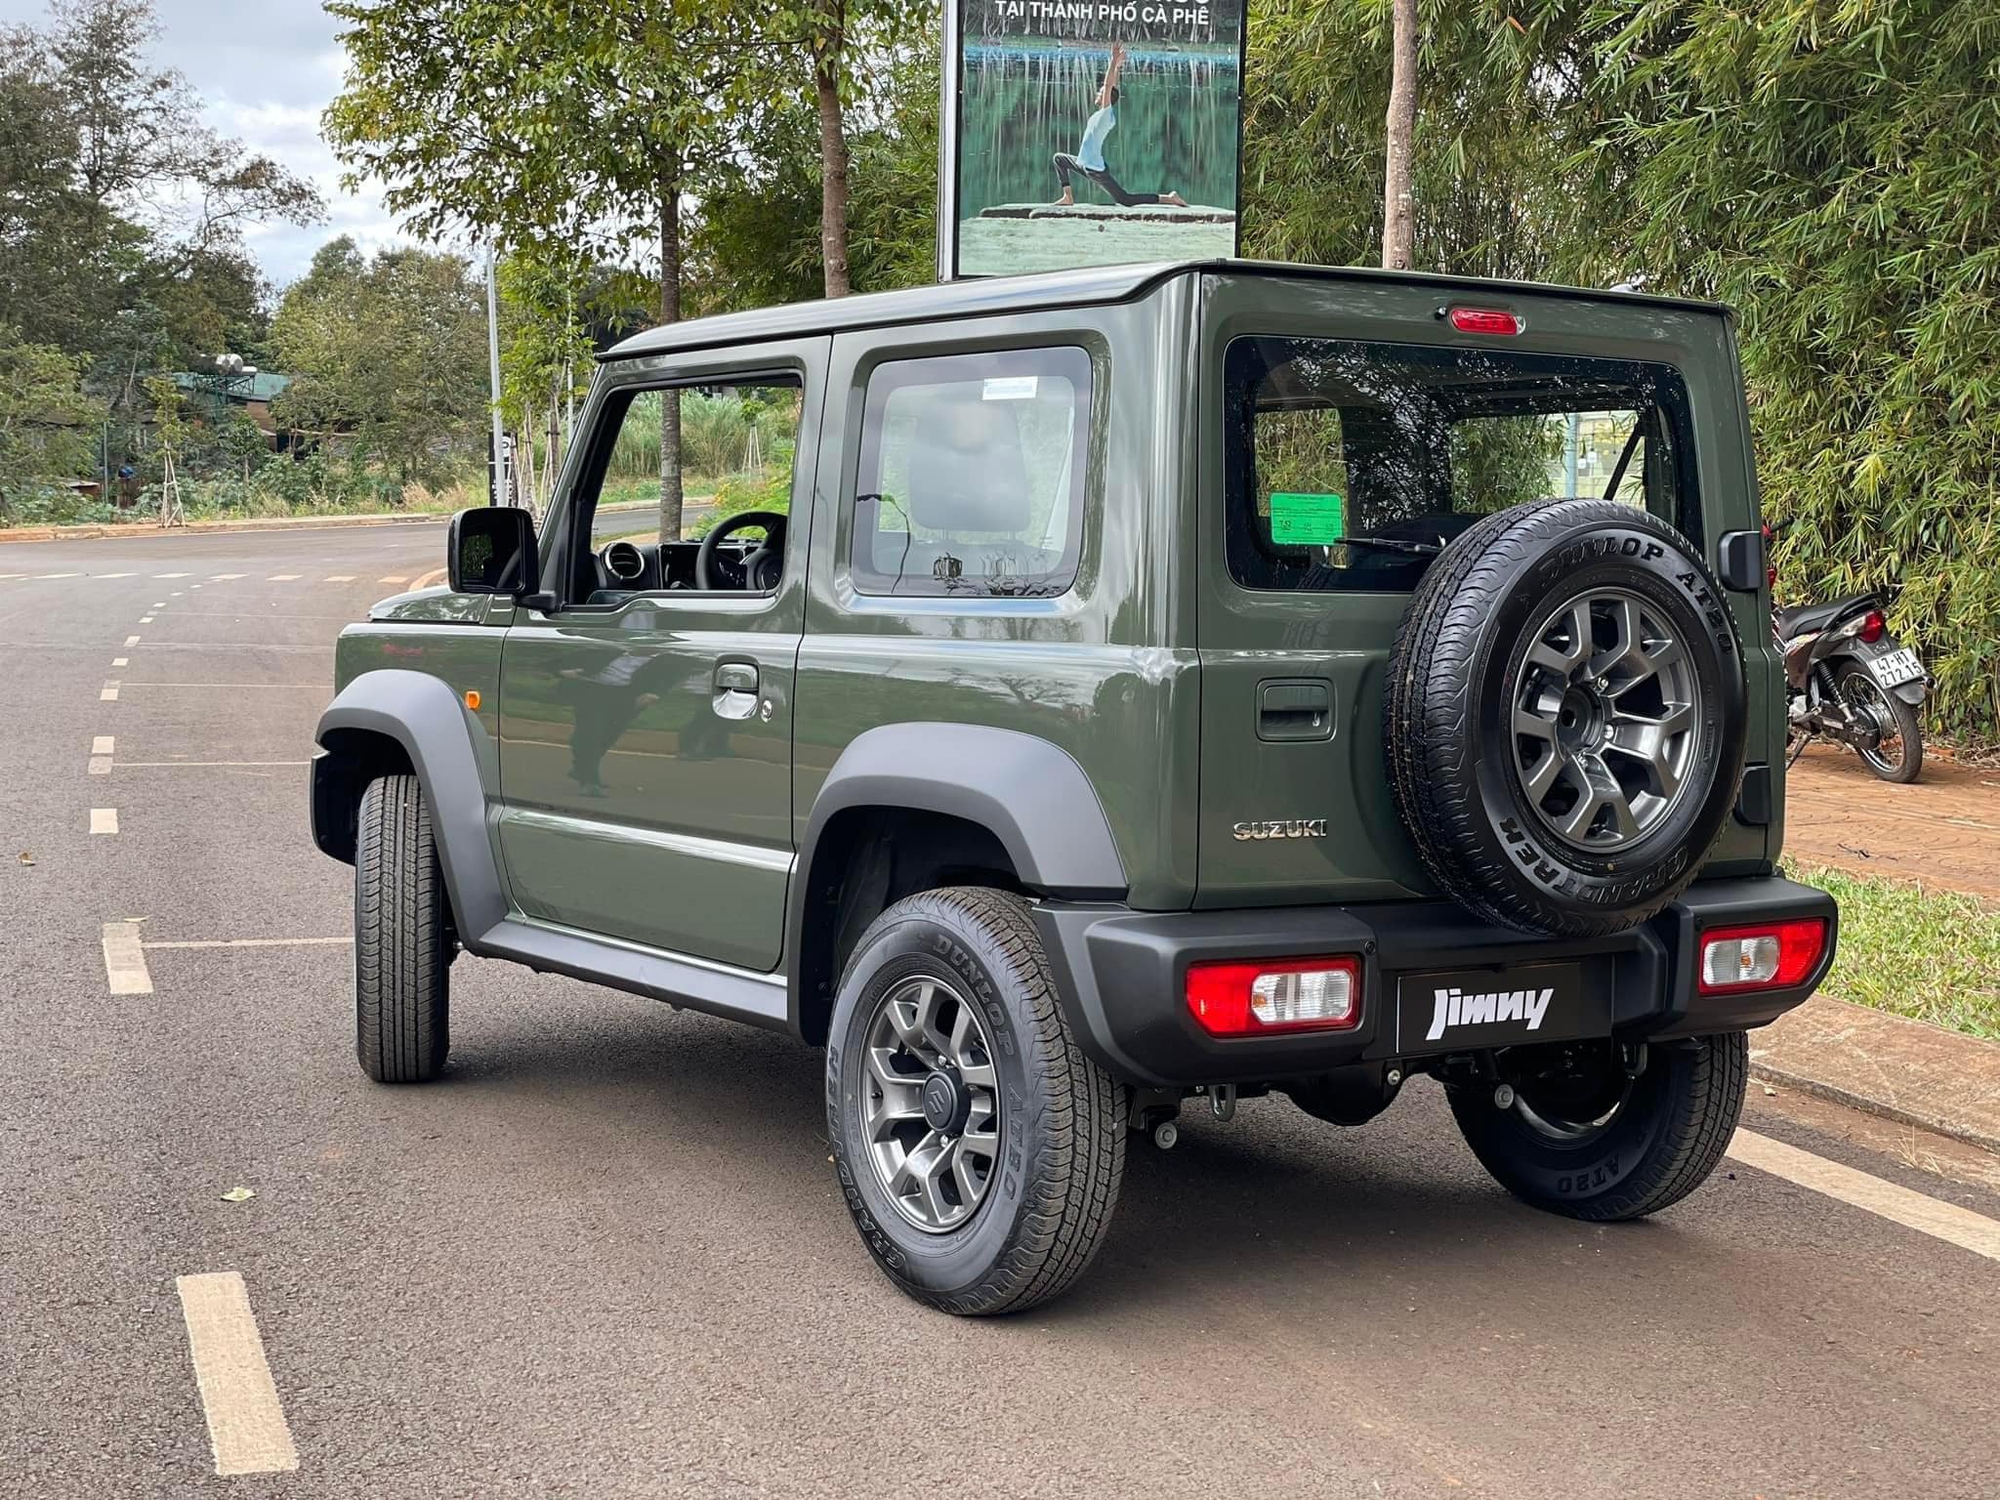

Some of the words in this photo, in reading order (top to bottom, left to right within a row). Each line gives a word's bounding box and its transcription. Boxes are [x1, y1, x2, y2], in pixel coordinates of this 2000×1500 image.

[995, 1, 1024, 19] TẠI
[1099, 0, 1138, 21] PHỐ
[1142, 4, 1167, 23] CÀ
[1173, 6, 1209, 25] PHÊ
[1539, 537, 1664, 588] DUNLOP
[1676, 571, 1732, 652] AT20
[1876, 651, 1909, 671] 47-H1
[1880, 661, 1922, 686] 272.15
[1233, 819, 1327, 841] SUZUKI
[933, 933, 1015, 1057] DUNLOP
[1425, 988, 1554, 1040] Jimny
[1558, 1152, 1620, 1193] AT20
